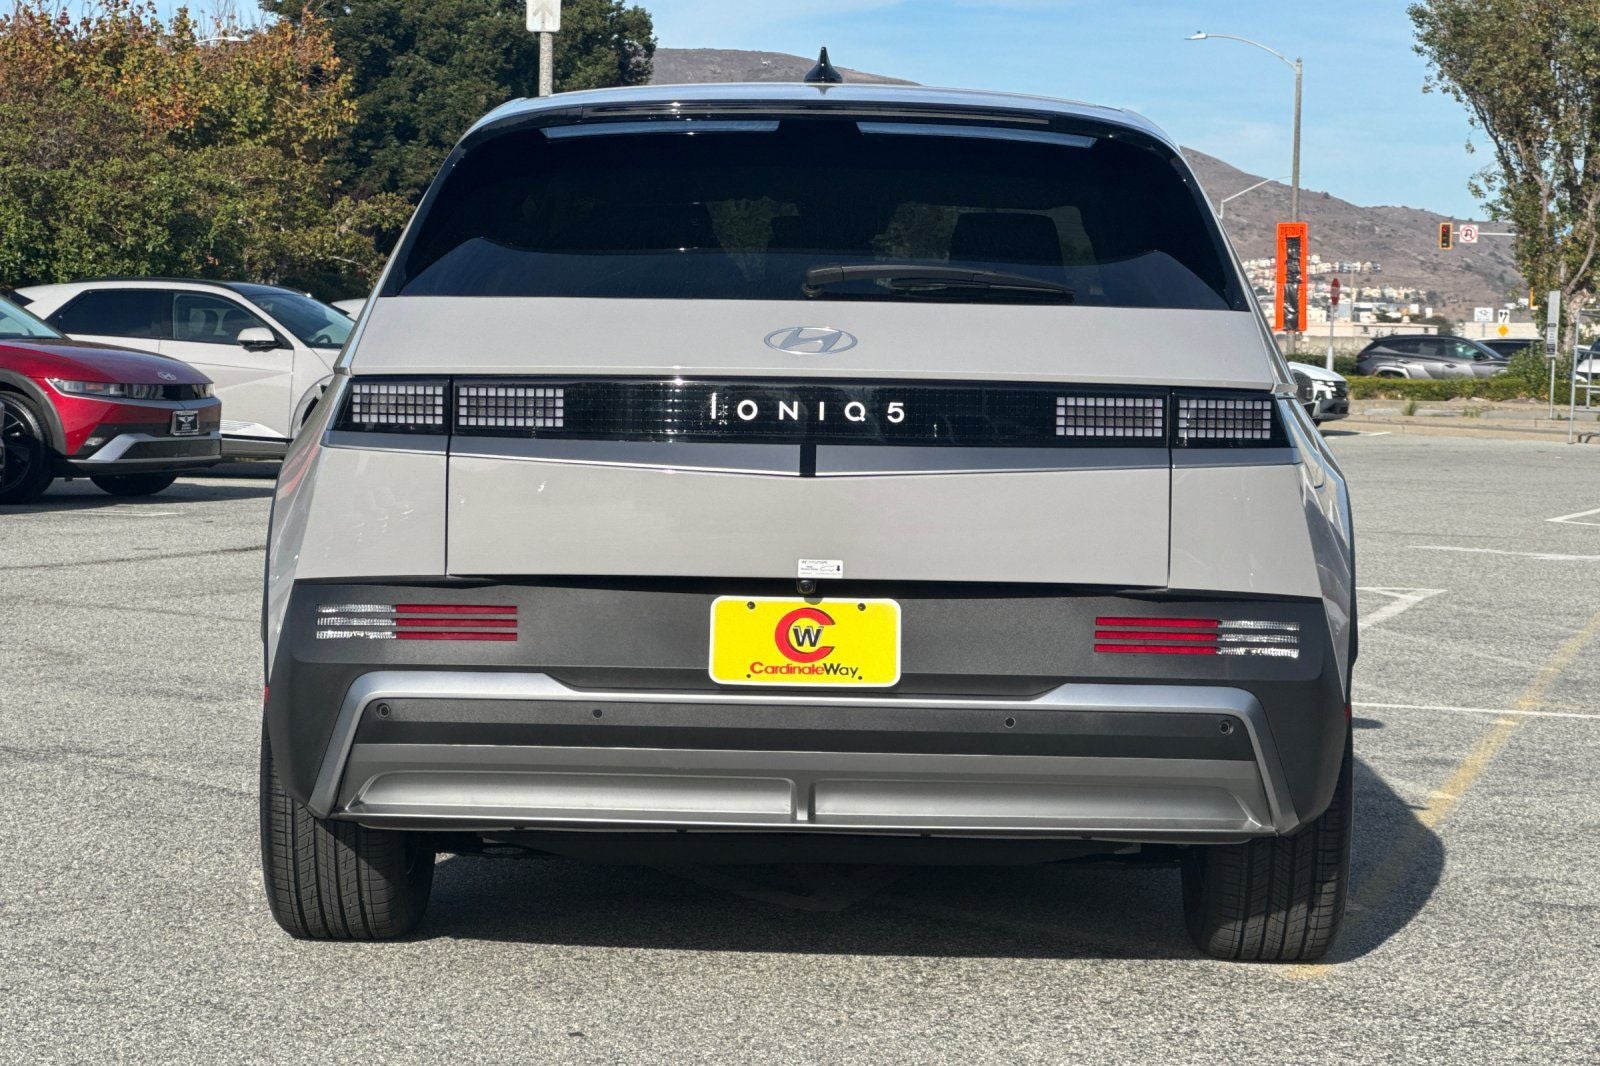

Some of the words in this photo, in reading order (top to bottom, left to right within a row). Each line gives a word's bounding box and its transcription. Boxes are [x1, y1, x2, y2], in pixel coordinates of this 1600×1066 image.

[710, 392, 867, 422] IONIQ
[887, 401, 905, 424] 5
[750, 661, 859, 678] CardinaleWay
